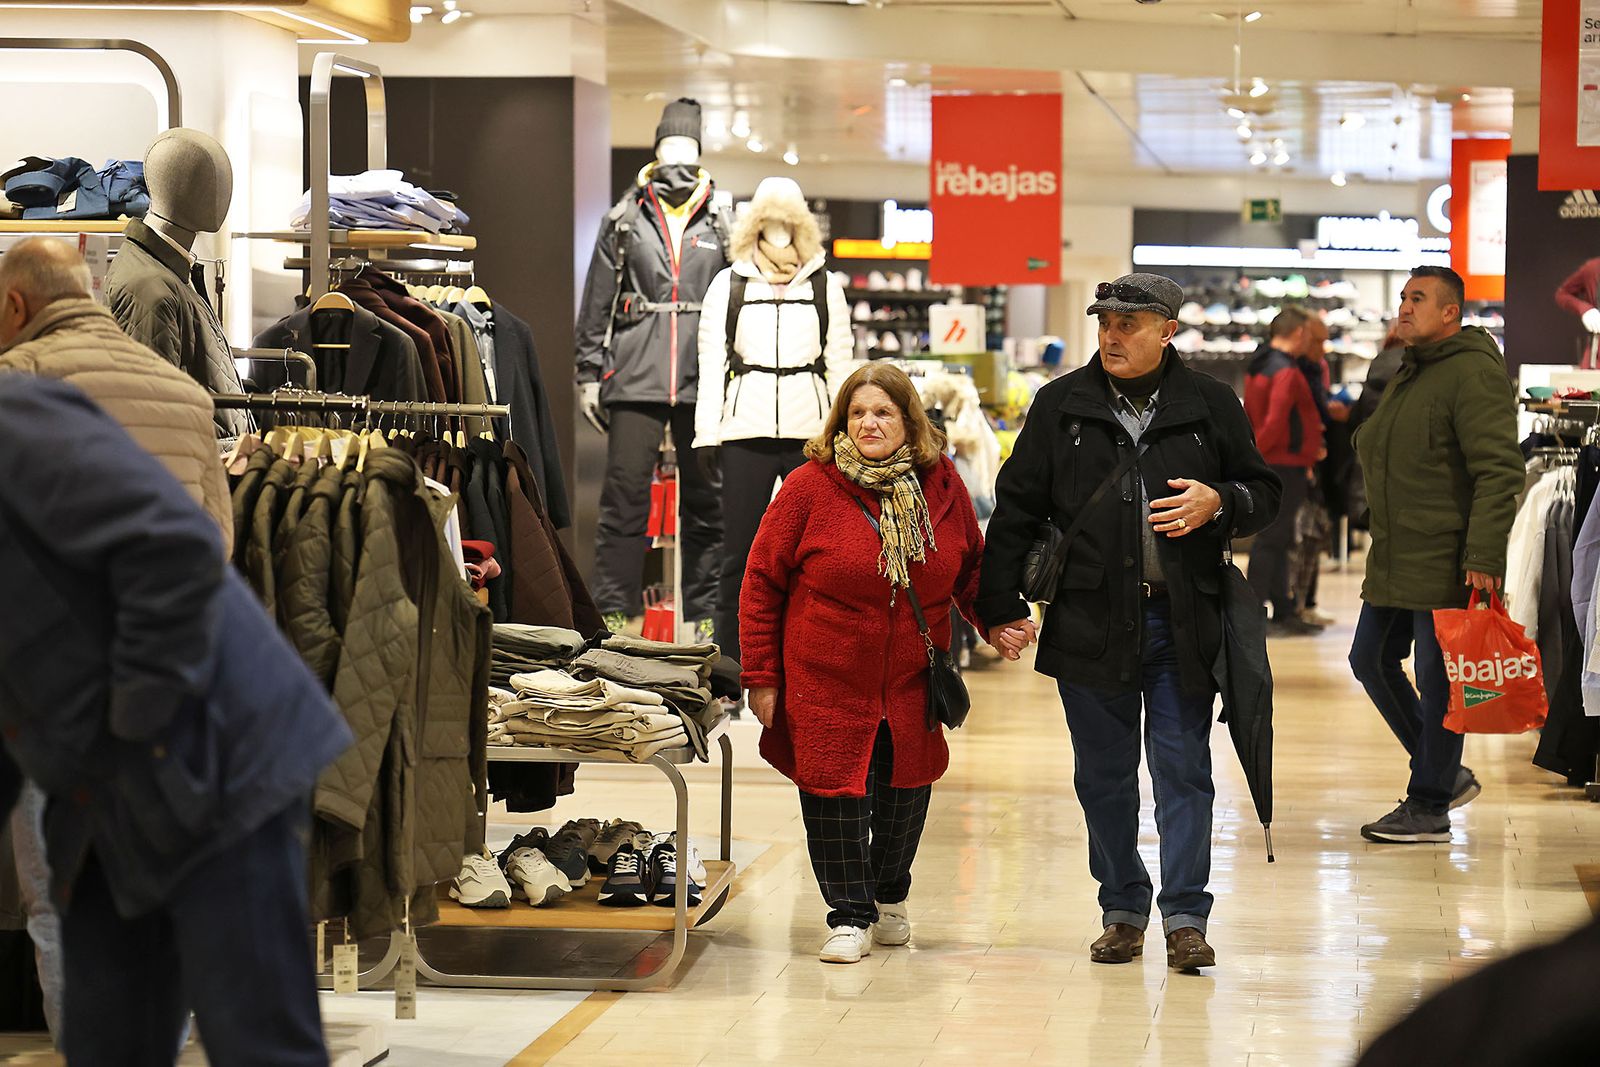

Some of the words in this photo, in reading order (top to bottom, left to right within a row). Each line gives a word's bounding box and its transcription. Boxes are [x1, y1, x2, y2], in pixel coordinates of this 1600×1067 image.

[1584, 17, 1600, 30] Se
[936, 164, 1057, 202] rebajas
[1445, 652, 1538, 687] ebajas
